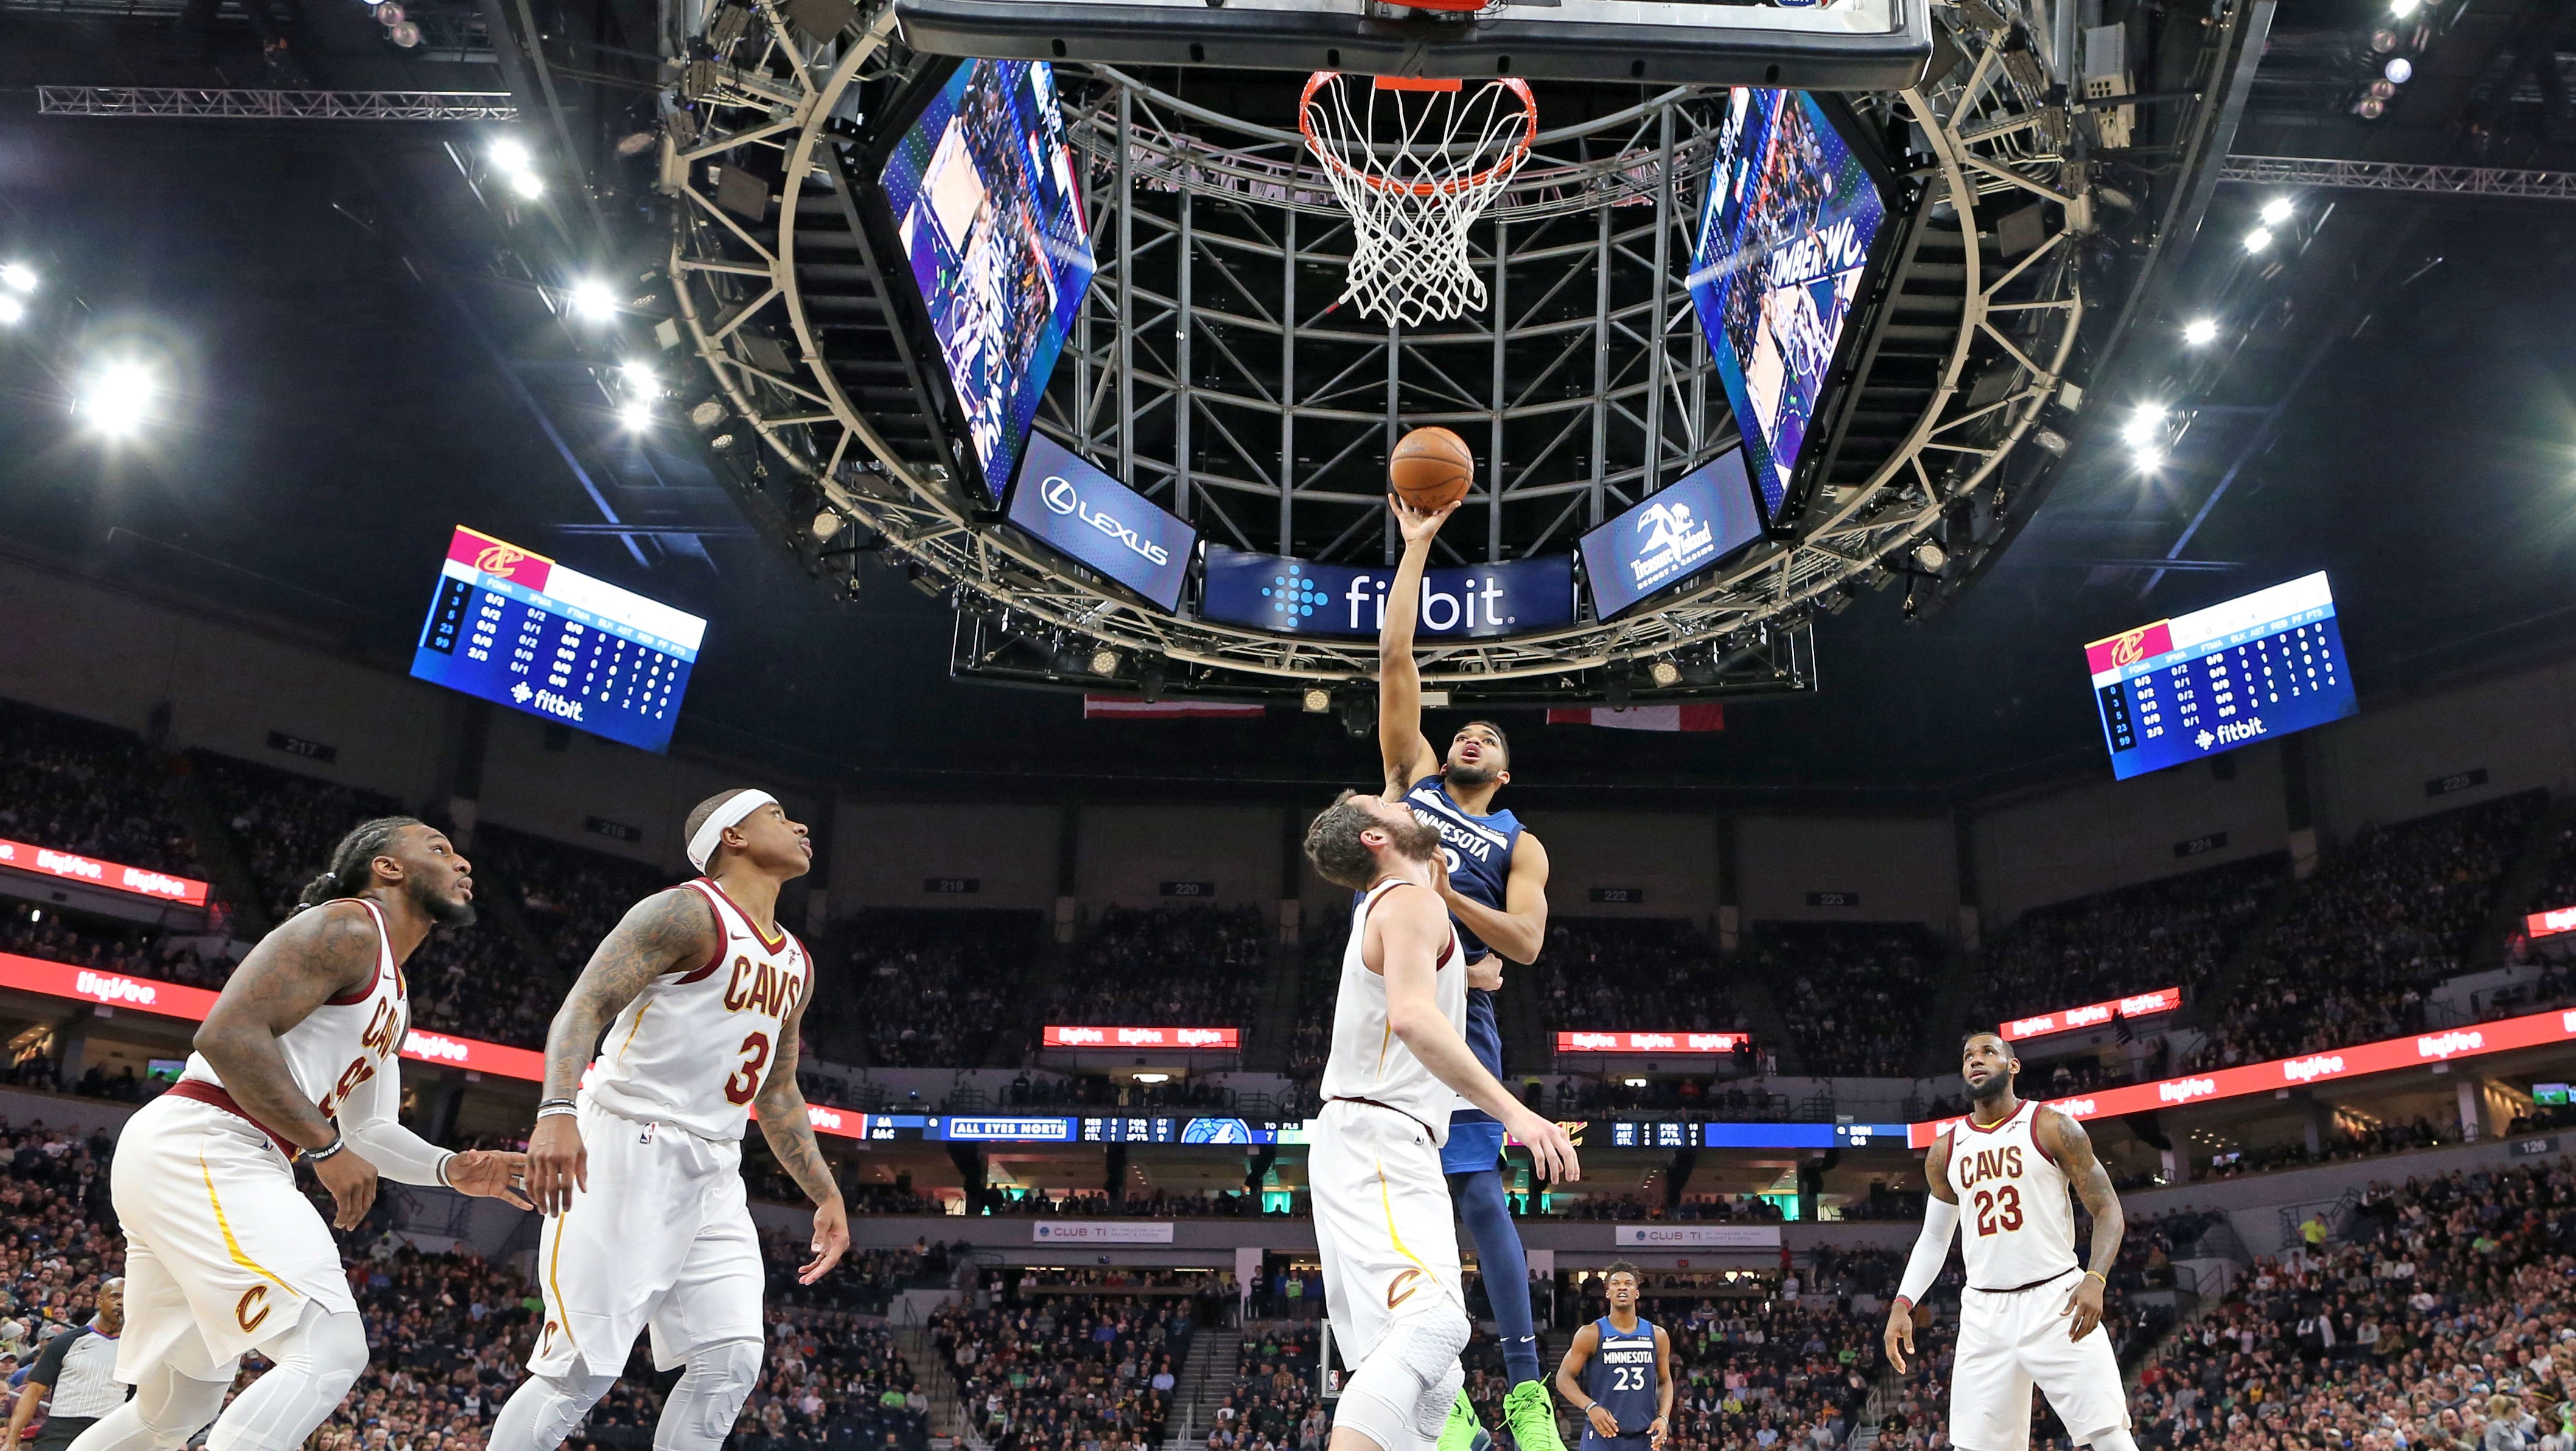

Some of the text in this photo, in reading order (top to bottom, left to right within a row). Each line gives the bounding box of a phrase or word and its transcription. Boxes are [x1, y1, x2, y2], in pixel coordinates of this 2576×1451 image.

[1079, 501, 1169, 566] LEXUS
[1630, 520, 1713, 580] Treasure Island
[1345, 575, 1503, 631] fibit
[287, 739, 317, 756] 217
[940, 880, 965, 892] 219
[1175, 884, 1199, 894] 220
[1603, 890, 1628, 901] 222
[1821, 893, 1844, 905] 223
[723, 955, 800, 1028] CAVS
[724, 1030, 769, 1107] 3
[2048, 1098, 2096, 1117] yVee
[877, 1117, 892, 1127] SA
[956, 1123, 979, 1133] ALL
[985, 1123, 1016, 1134] EYES
[872, 1129, 895, 1139] SAC
[1267, 1132, 1273, 1141] 7
[1850, 1136, 1867, 1146] GS
[2522, 1139, 2547, 1153] 126
[1960, 1145, 2023, 1189] CAVS
[1974, 1185, 2023, 1237] 23
[1054, 1228, 1088, 1237] CLUB
[1096, 1228, 1106, 1237] TI
[1603, 1351, 1653, 1364] MINNESOTA
[1612, 1367, 1645, 1391] 23
